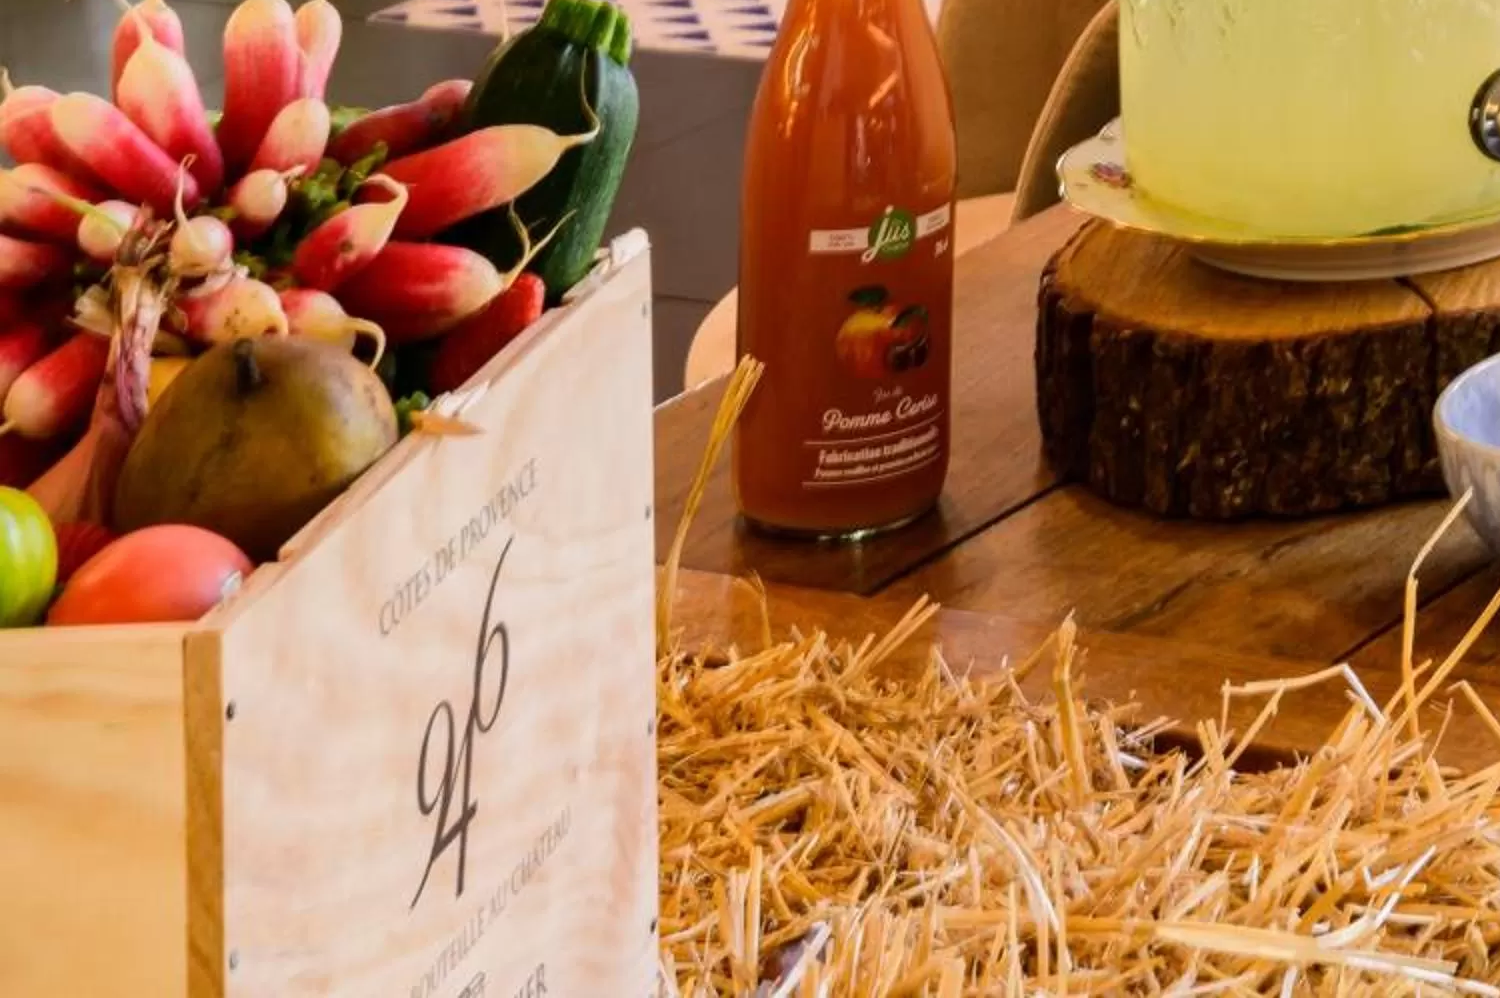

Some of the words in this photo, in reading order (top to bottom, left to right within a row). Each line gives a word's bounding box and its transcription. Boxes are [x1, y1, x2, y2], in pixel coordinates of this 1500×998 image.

[822, 407, 893, 432] Pomme
[379, 559, 432, 635] CÔTES
[434, 535, 458, 586] DE
[458, 457, 539, 562] PROVENCE
